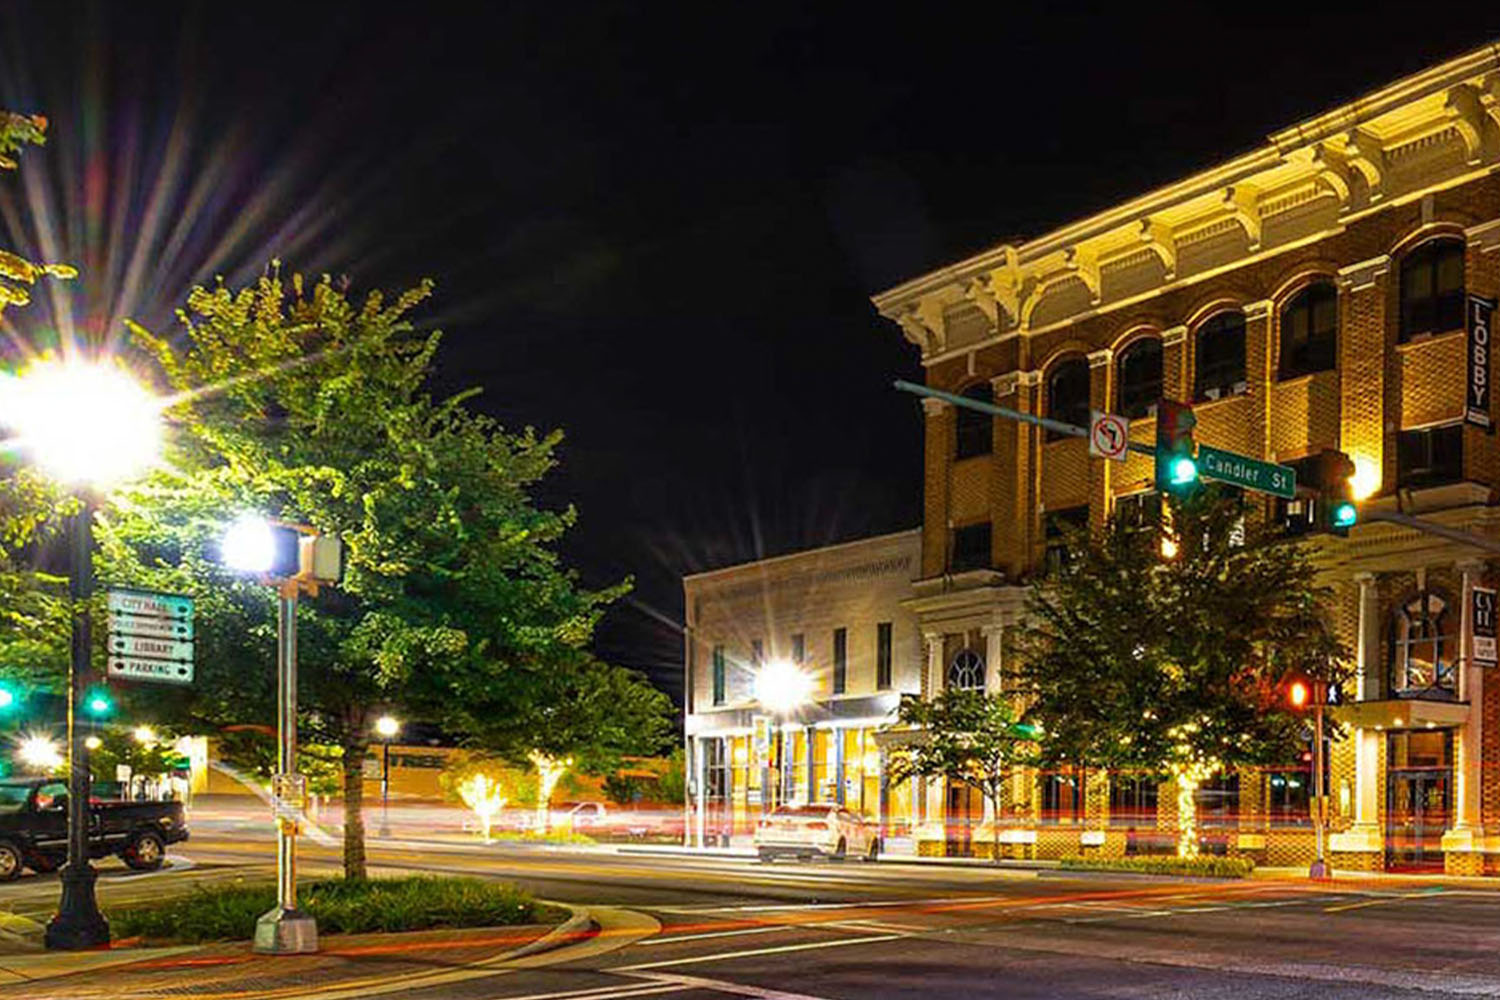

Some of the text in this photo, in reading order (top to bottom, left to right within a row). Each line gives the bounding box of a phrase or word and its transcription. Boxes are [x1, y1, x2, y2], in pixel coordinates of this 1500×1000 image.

[1472, 303, 1488, 406] LOBBY
[1206, 453, 1287, 489] Candler St
[134, 641, 174, 654] LIBRARY
[129, 661, 171, 675] PARKING
